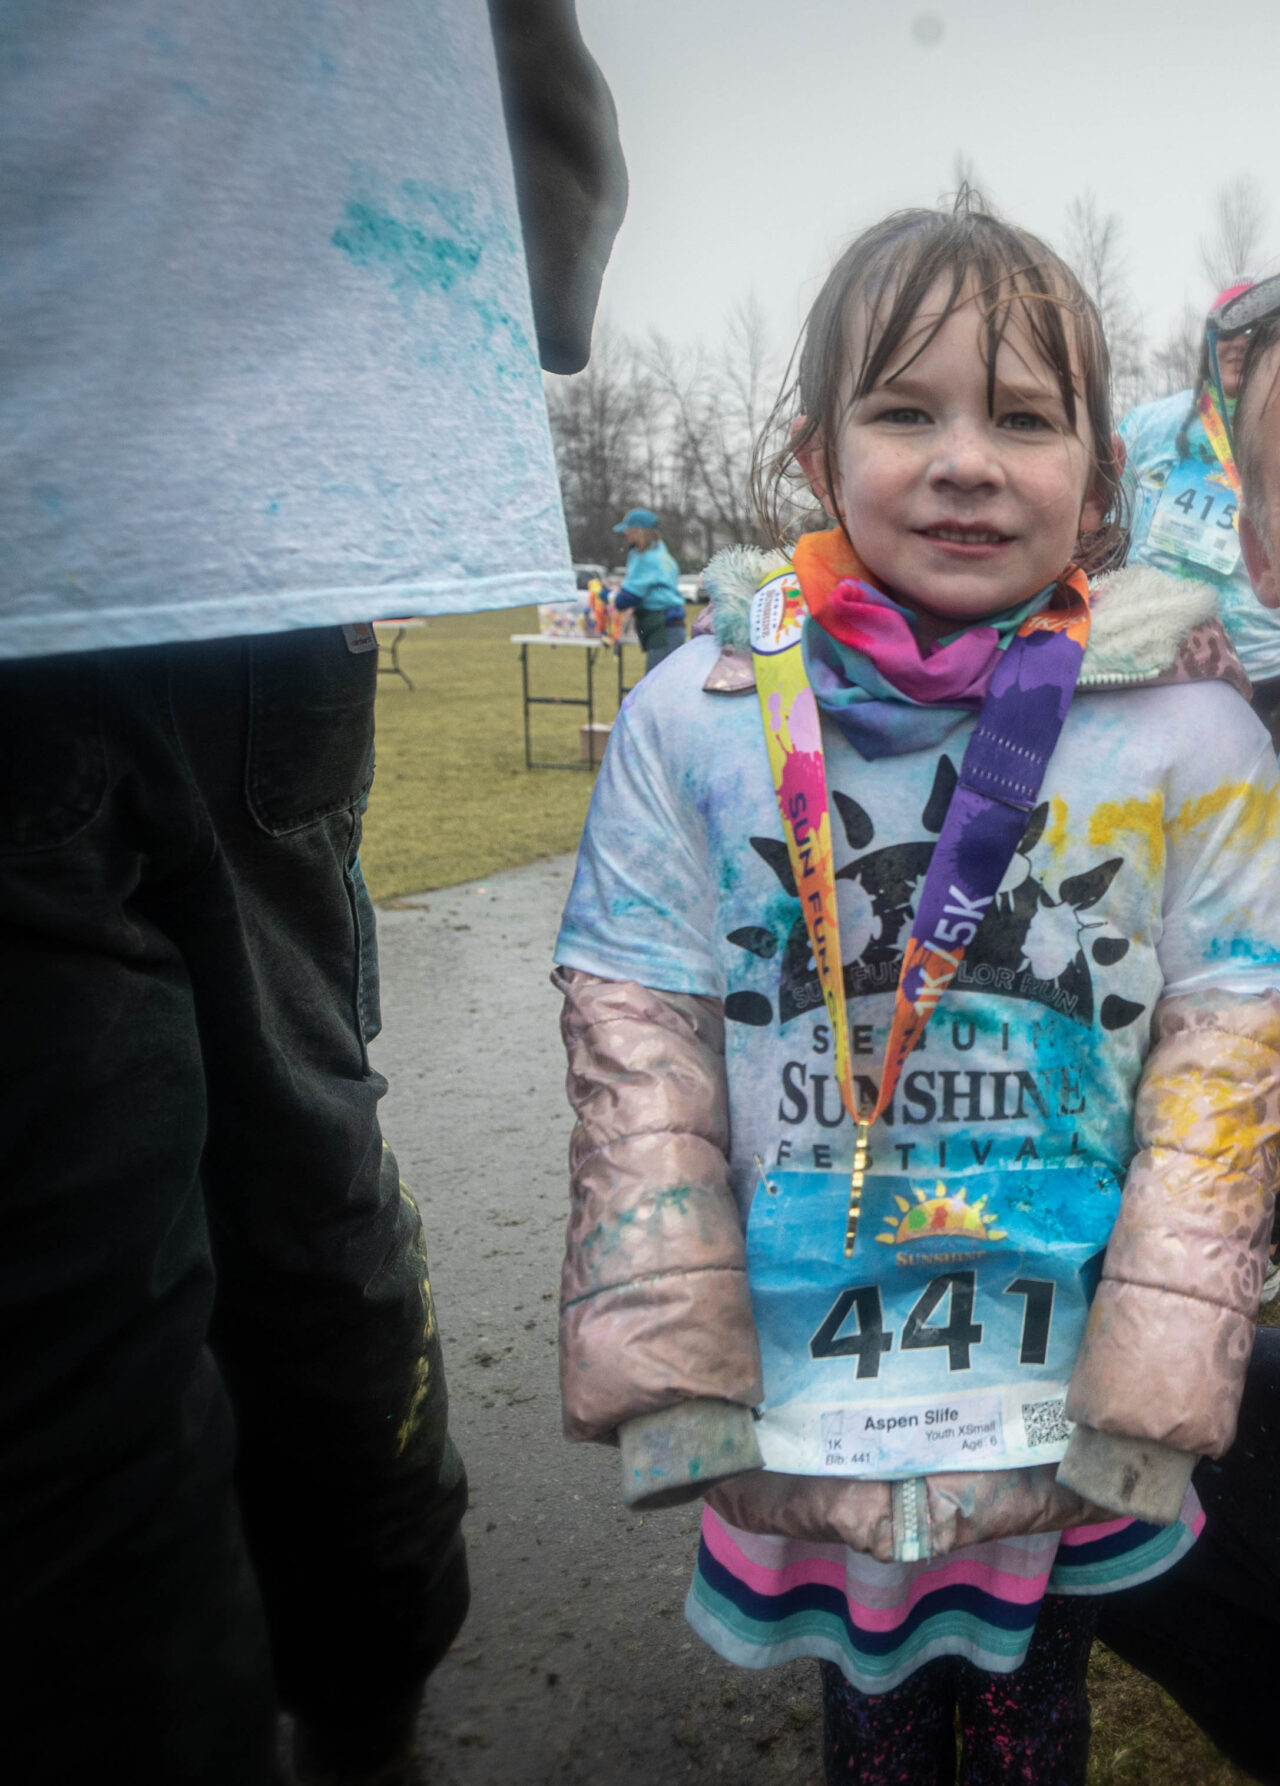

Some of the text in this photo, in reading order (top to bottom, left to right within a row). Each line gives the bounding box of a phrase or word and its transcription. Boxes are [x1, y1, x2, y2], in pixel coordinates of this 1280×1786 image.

[1173, 488, 1237, 530] 415
[789, 792, 829, 974] SUN FUN
[914, 885, 994, 1016] 1K/5K
[791, 980, 824, 1009] SU
[957, 960, 1016, 990] LOR
[1020, 974, 1078, 1014] RUN
[808, 1269, 1056, 1380] 441
[864, 1407, 959, 1433] Aspen Slife
[925, 1420, 996, 1442] Youth XSmall
[828, 1439, 842, 1450] 1K
[851, 1453, 871, 1464] 441
